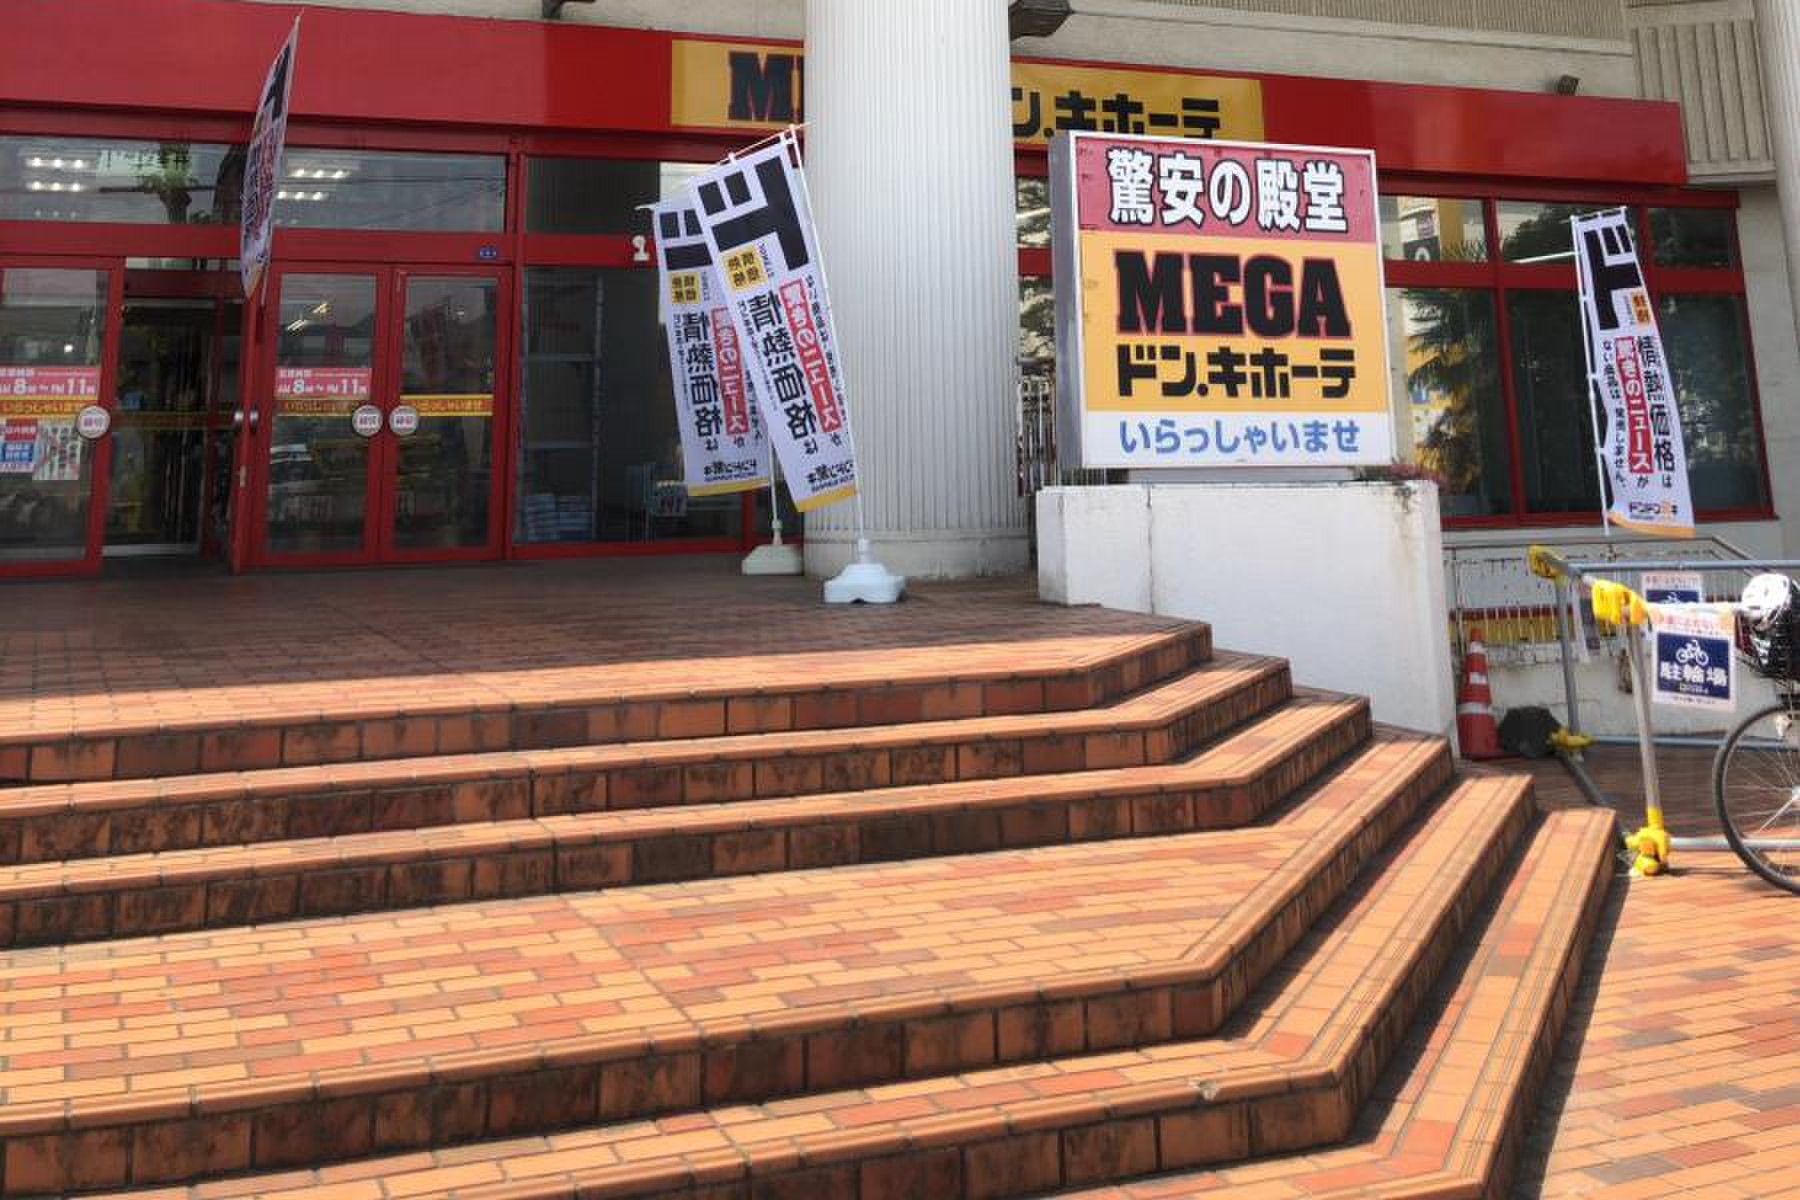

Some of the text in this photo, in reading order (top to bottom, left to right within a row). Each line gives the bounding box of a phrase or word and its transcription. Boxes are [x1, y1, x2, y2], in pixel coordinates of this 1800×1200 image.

[1107, 147, 1347, 232] 驚安の殿堂
[1115, 250, 1352, 339] MEGA
[1120, 420, 1360, 454] いらっしゃいませ
[1660, 661, 1728, 688] 駐輪場
